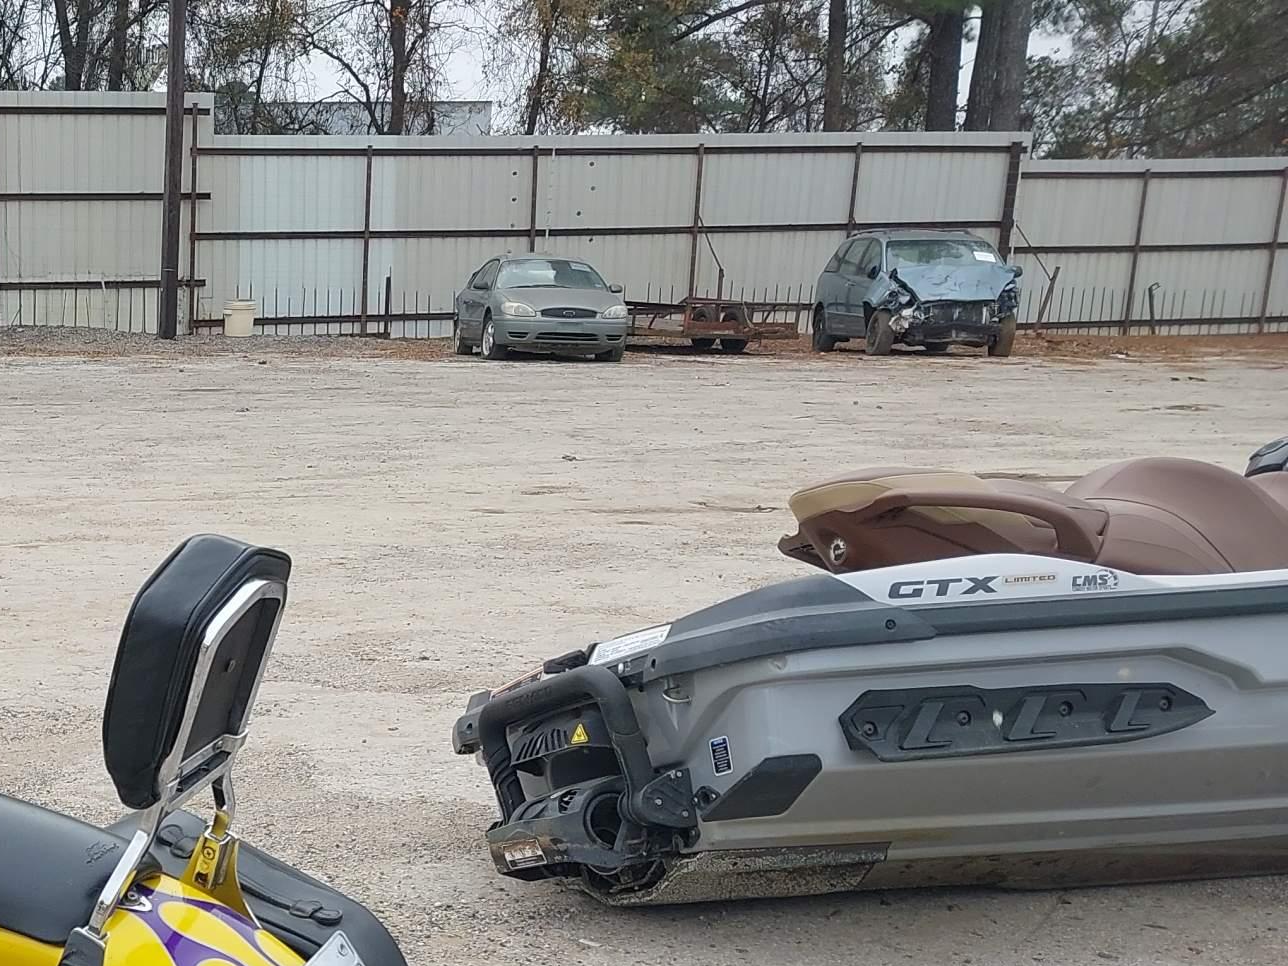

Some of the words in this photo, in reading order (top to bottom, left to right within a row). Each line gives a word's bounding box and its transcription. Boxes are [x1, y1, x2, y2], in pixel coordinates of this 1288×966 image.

[888, 576, 1000, 599] GTX
[1004, 574, 1056, 584] LIMITED
[1072, 574, 1109, 587] CMS
